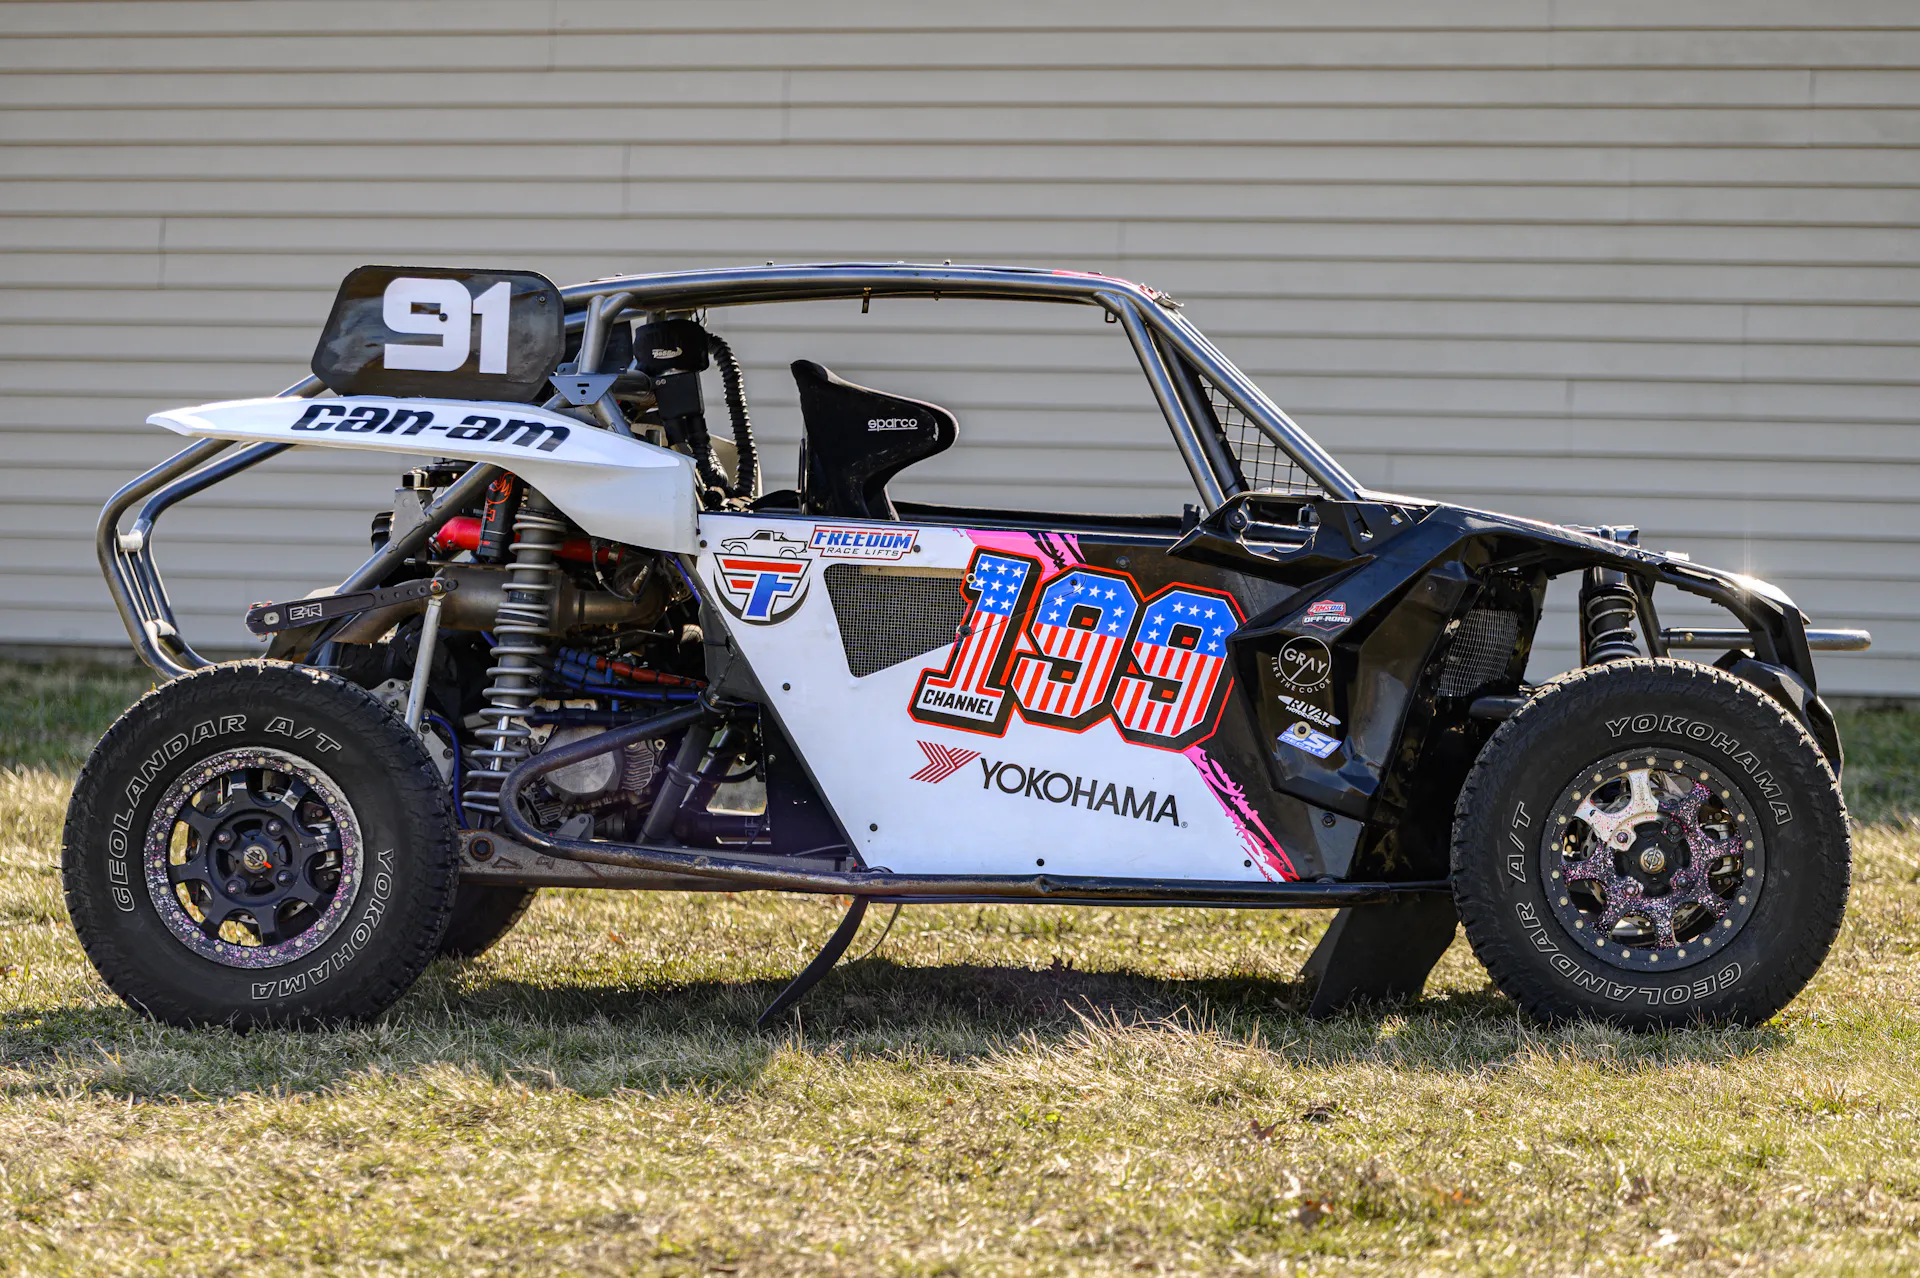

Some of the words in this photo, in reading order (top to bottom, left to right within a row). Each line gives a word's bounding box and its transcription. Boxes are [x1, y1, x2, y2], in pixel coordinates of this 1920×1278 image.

[383, 277, 511, 374] 91
[291, 404, 570, 452] can-am
[868, 418, 918, 431] sparco
[814, 529, 913, 549] FREEDOM
[827, 547, 859, 556] RACE
[865, 548, 899, 557] LIFTS
[1312, 604, 1345, 613] AMSOIL
[924, 553, 1239, 738] 199
[1283, 648, 1327, 682] GRAY
[1271, 656, 1282, 679] LIKE
[1280, 678, 1296, 692] THE
[1299, 678, 1331, 694] COLOR
[922, 689, 994, 717] CHANNEL
[1604, 713, 1793, 826] YOKOHAMA
[107, 714, 247, 912] GEOLANDAR
[265, 716, 342, 753] A/T
[1507, 801, 1533, 884] A/T
[251, 848, 394, 1001] YOKOHAMA
[1516, 902, 1742, 1006] GEOLANDAR
